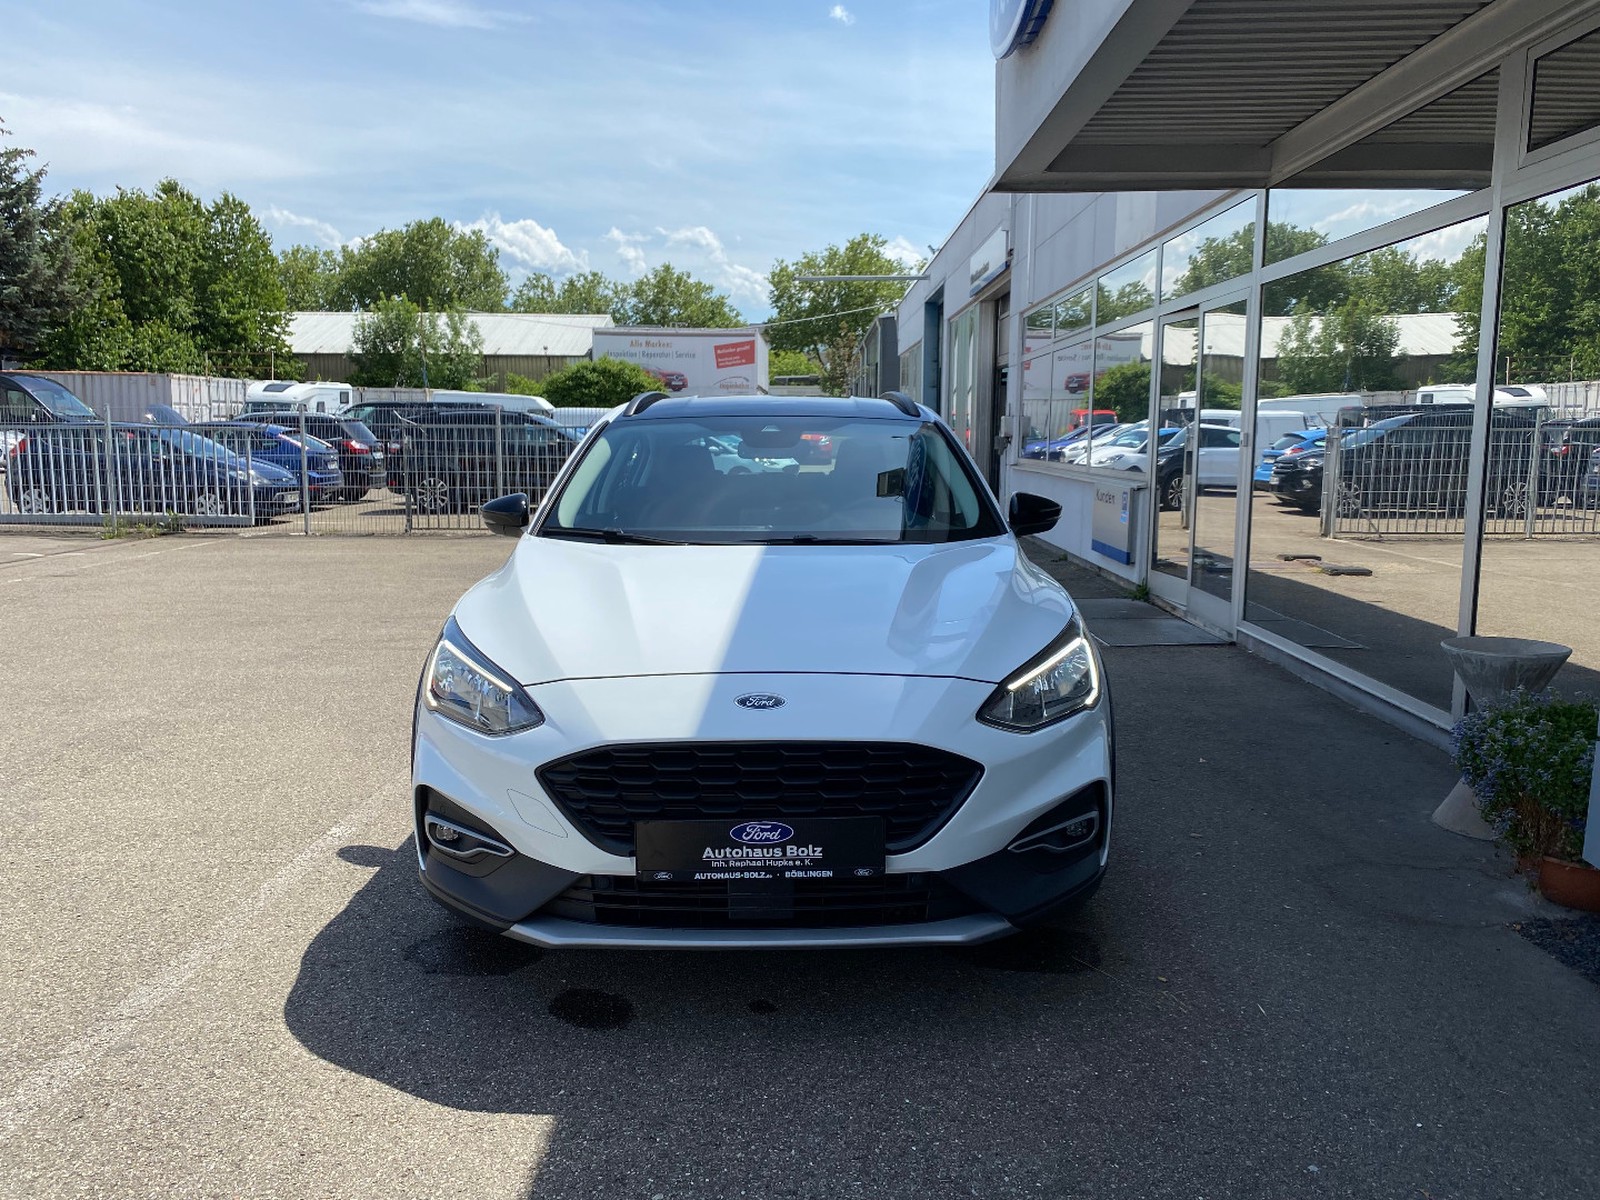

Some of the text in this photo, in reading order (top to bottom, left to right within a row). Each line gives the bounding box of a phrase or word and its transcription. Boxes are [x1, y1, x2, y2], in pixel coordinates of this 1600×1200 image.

[629, 340, 673, 348] Alle Marken:
[607, 349, 696, 359] Inspektion Reparatur Service
[746, 696, 776, 706] Ford
[742, 825, 782, 840] Ford
[702, 844, 823, 859] Autohaus Bolz
[711, 860, 728, 868] Inh.
[730, 859, 765, 869] Raphael
[804, 859, 814, 867] K.
[784, 869, 834, 878] BÖBLINGEN
